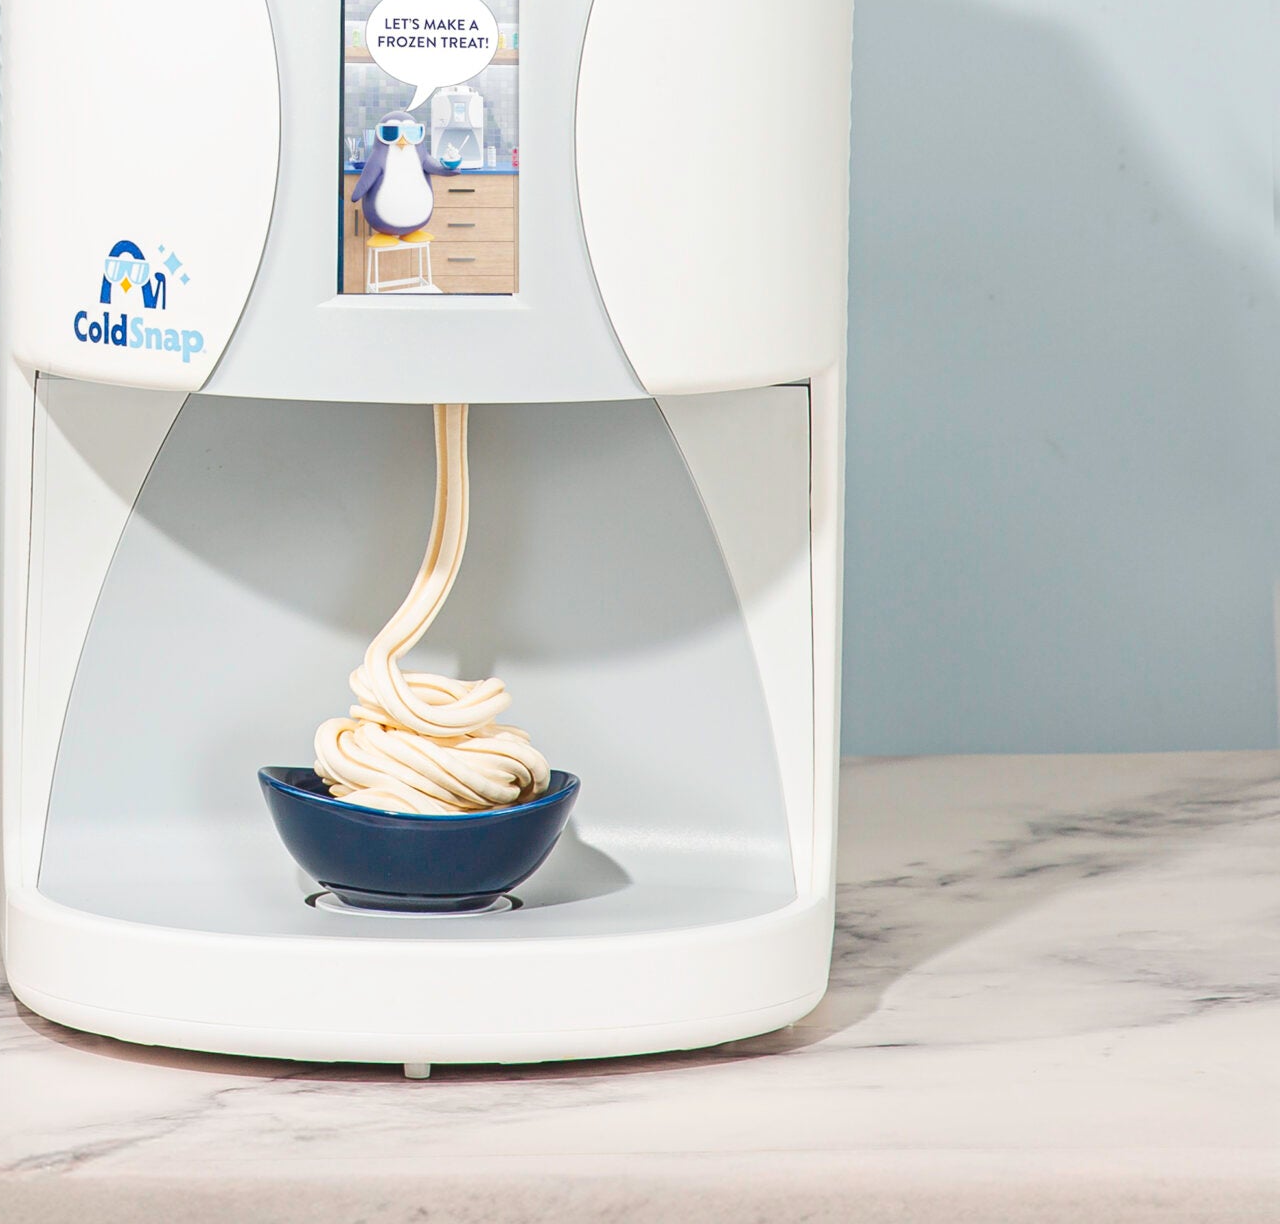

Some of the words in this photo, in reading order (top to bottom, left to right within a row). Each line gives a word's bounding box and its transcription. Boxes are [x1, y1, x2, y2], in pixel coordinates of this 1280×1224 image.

[384, 18, 420, 30] LET'S
[423, 19, 465, 31] MAKE
[468, 20, 479, 31] A
[377, 36, 437, 48] FROZEN
[440, 37, 489, 49] TREAT!
[73, 310, 205, 364] ColdSnap
